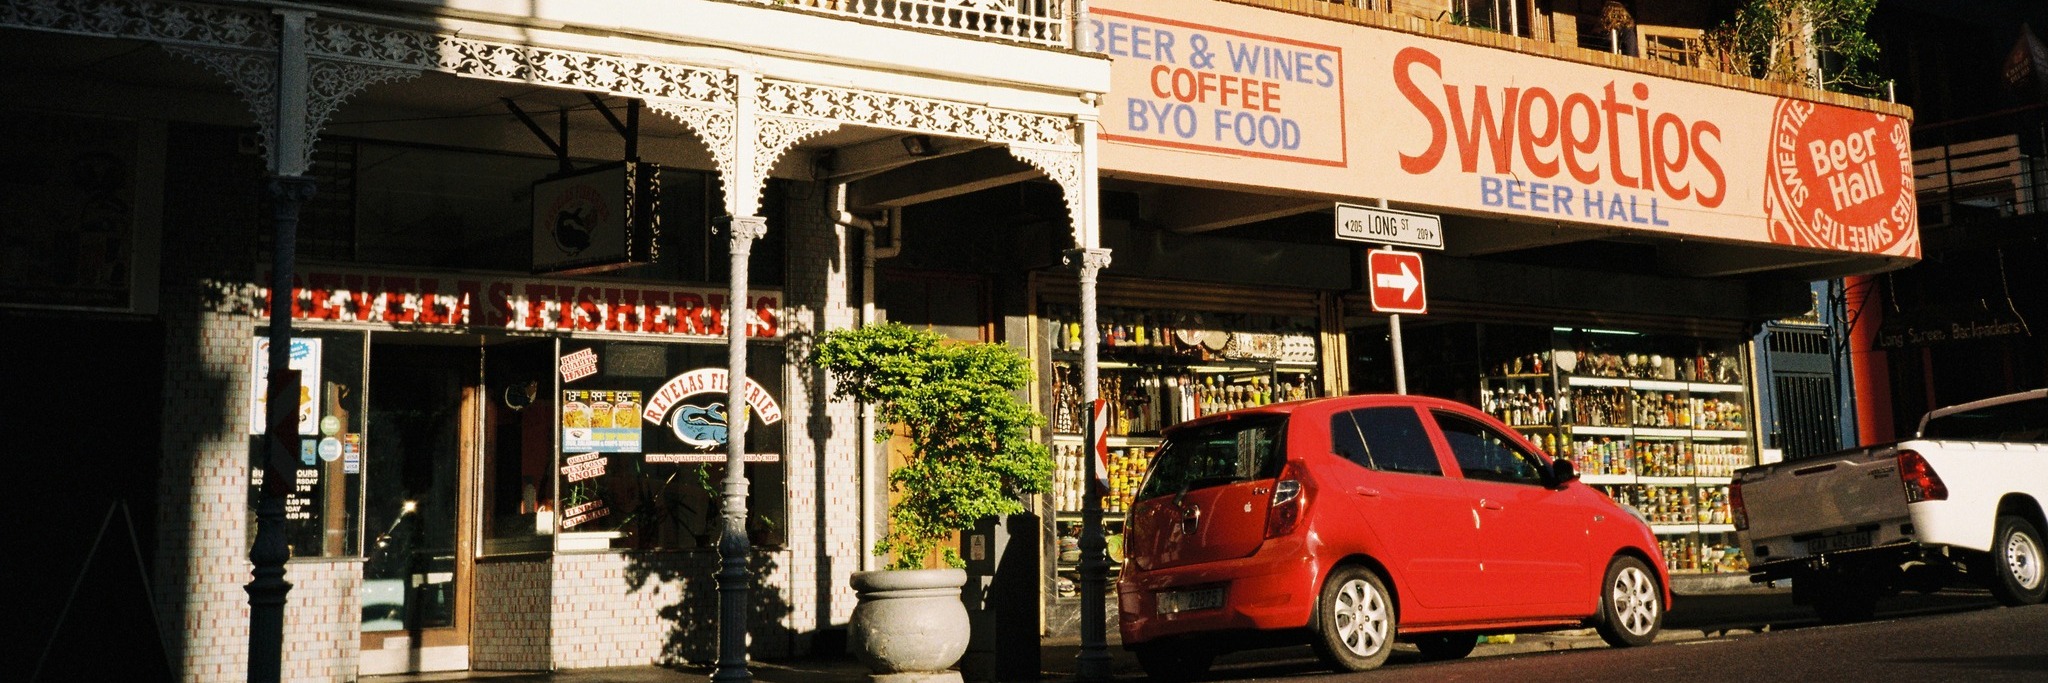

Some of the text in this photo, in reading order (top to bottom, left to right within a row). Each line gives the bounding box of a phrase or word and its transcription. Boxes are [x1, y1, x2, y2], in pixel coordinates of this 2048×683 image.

[1189, 33, 1215, 70] &
[1226, 40, 1334, 88] WINES
[1150, 65, 1281, 113] COFFEE
[1127, 97, 1301, 150] BYO FOOD
[1393, 46, 1726, 208] Sweeties
[1808, 127, 1877, 177] Beer
[1480, 175, 1669, 227] BEER HALL
[1827, 159, 1885, 212] Hall
[1889, 123, 1912, 231] SWEETIES
[1350, 214, 1429, 240] 205 LONG ST 209
[1811, 207, 1893, 252] SWEETIES
[525, 284, 778, 338] FISHERIS
[561, 355, 597, 373] QUALITY
[562, 348, 592, 365] PRIME
[565, 364, 596, 381] HAKE
[646, 373, 779, 422] REVELAS FIERIES
[296, 469, 318, 478] OURS
